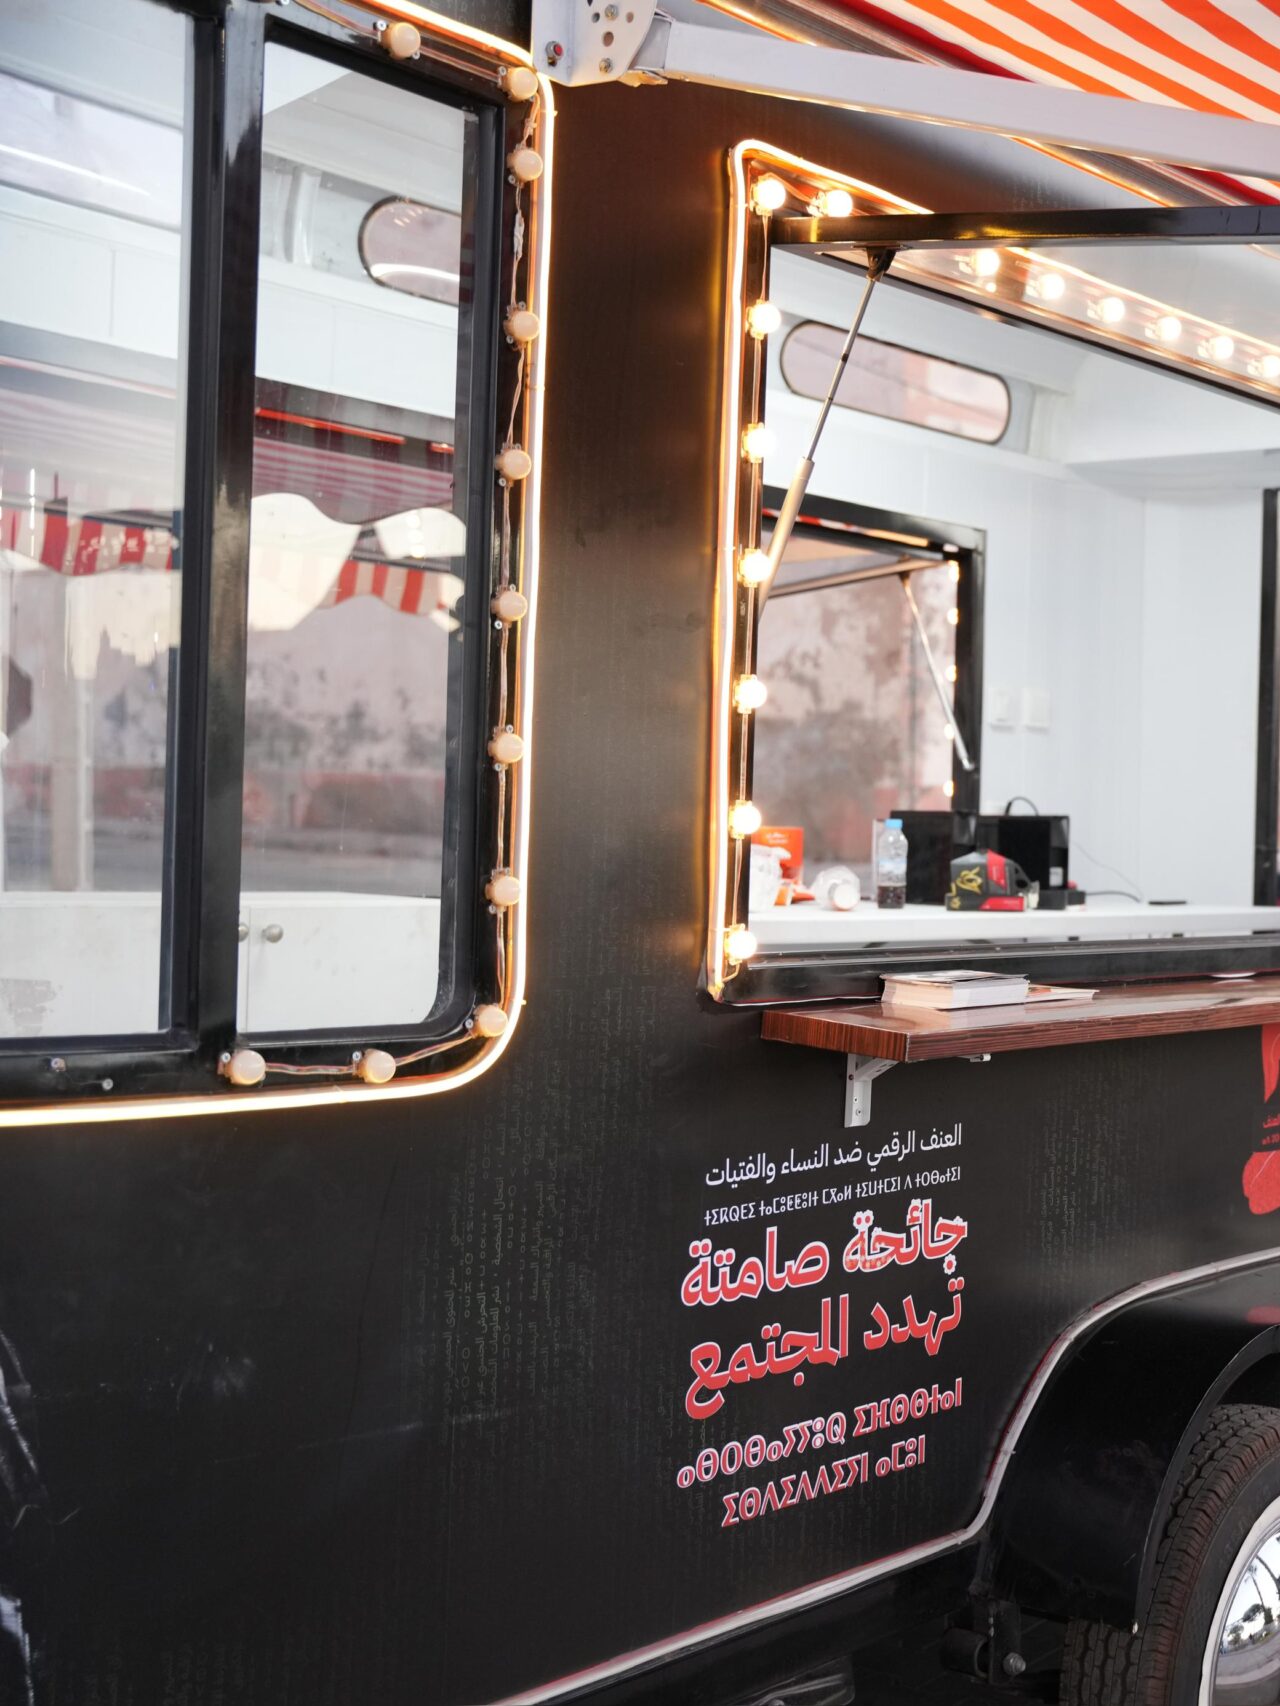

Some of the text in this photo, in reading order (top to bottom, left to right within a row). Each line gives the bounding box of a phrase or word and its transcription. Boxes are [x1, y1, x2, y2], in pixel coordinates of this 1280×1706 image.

[705, 1123, 962, 1189] العنف الرقمي ضد النساء والفتيات
[680, 1226, 830, 1307] صامتة
[842, 1198, 968, 1275] جائحة
[863, 1277, 965, 1356] تهدد
[685, 1293, 849, 1420] المجتمع
